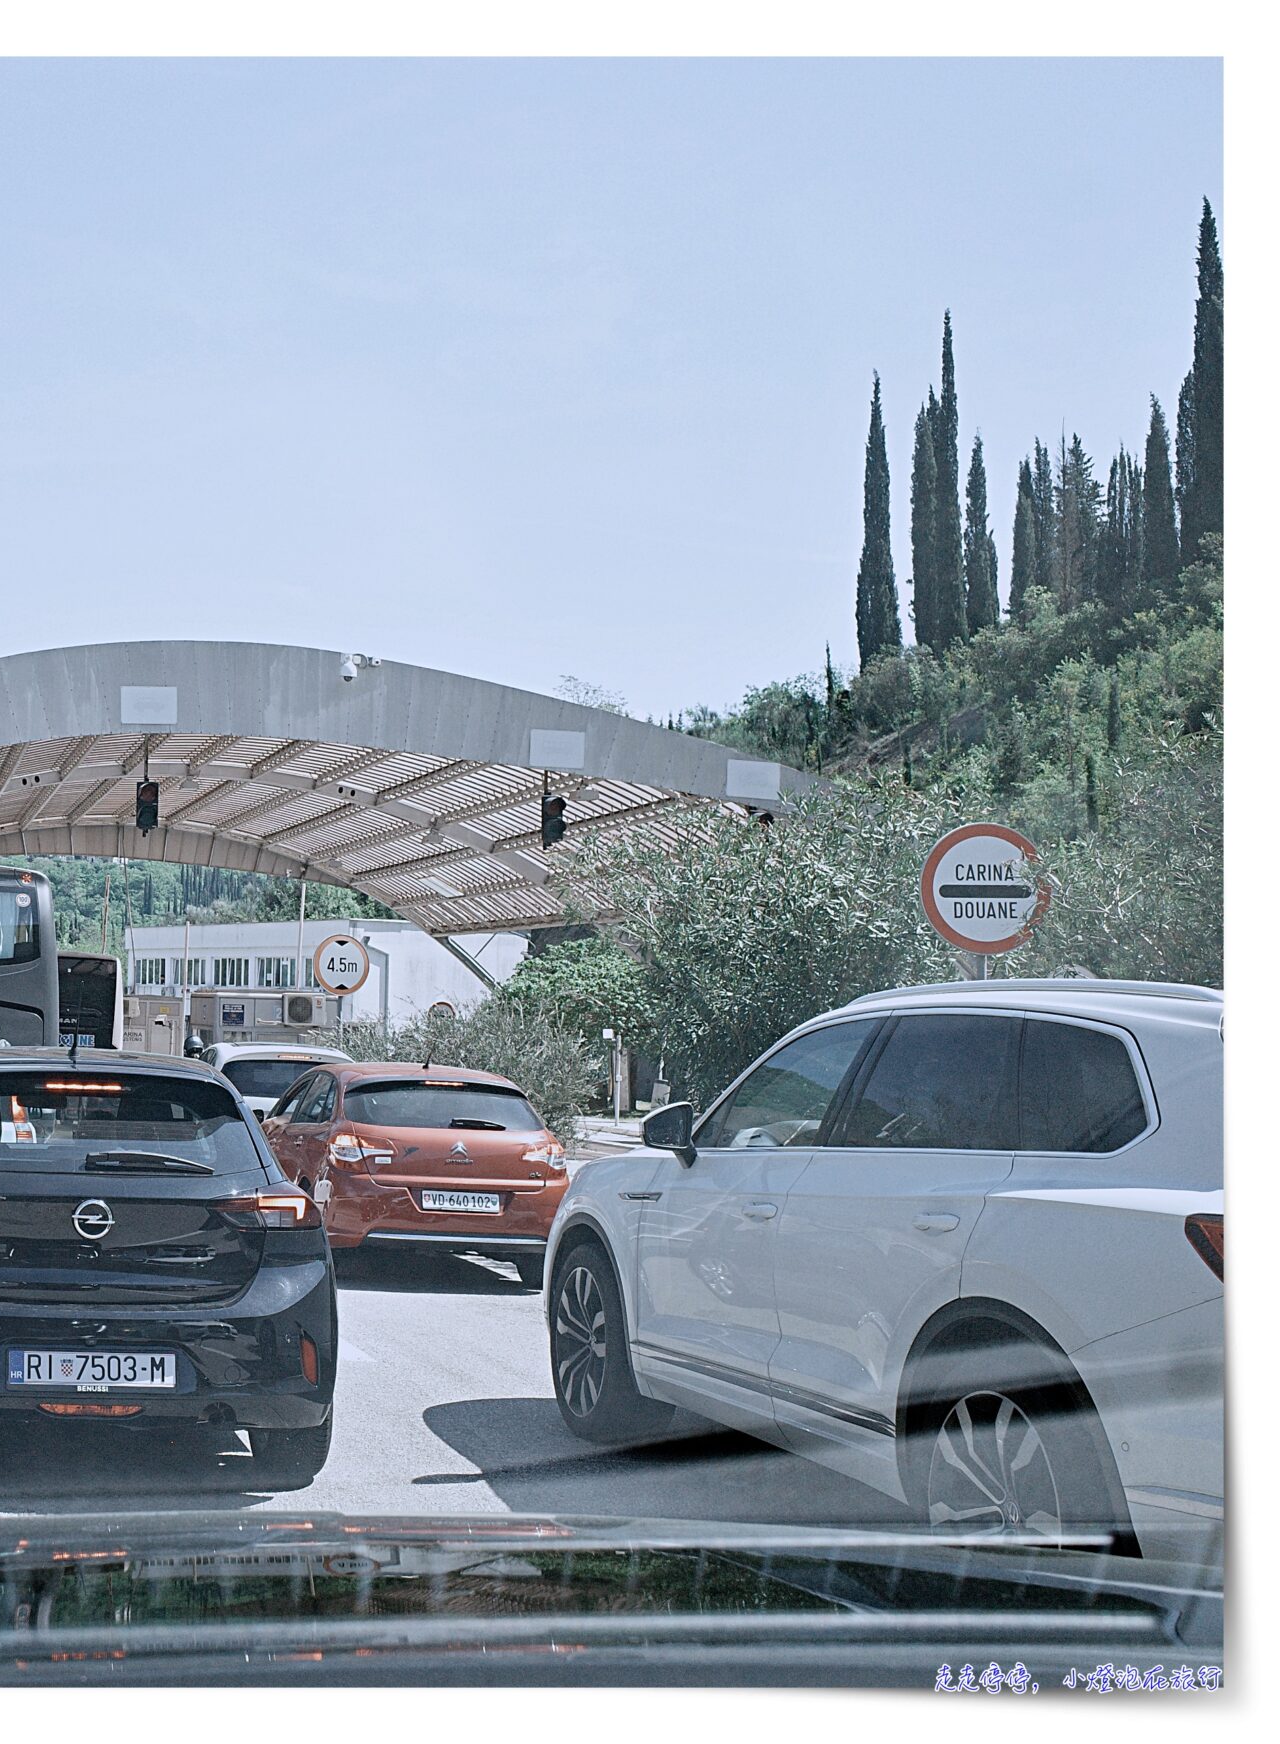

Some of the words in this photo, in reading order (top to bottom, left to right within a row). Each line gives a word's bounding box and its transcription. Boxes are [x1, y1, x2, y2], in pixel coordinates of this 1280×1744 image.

[955, 863, 1014, 881] CARINA
[953, 901, 1018, 919] DOUANE
[327, 957, 358, 973] 4.5m
[10, 1370, 23, 1379] HR
[27, 1354, 53, 1380] RI
[75, 1354, 166, 1383] 7503-M
[76, 1385, 109, 1393] BENUSSI
